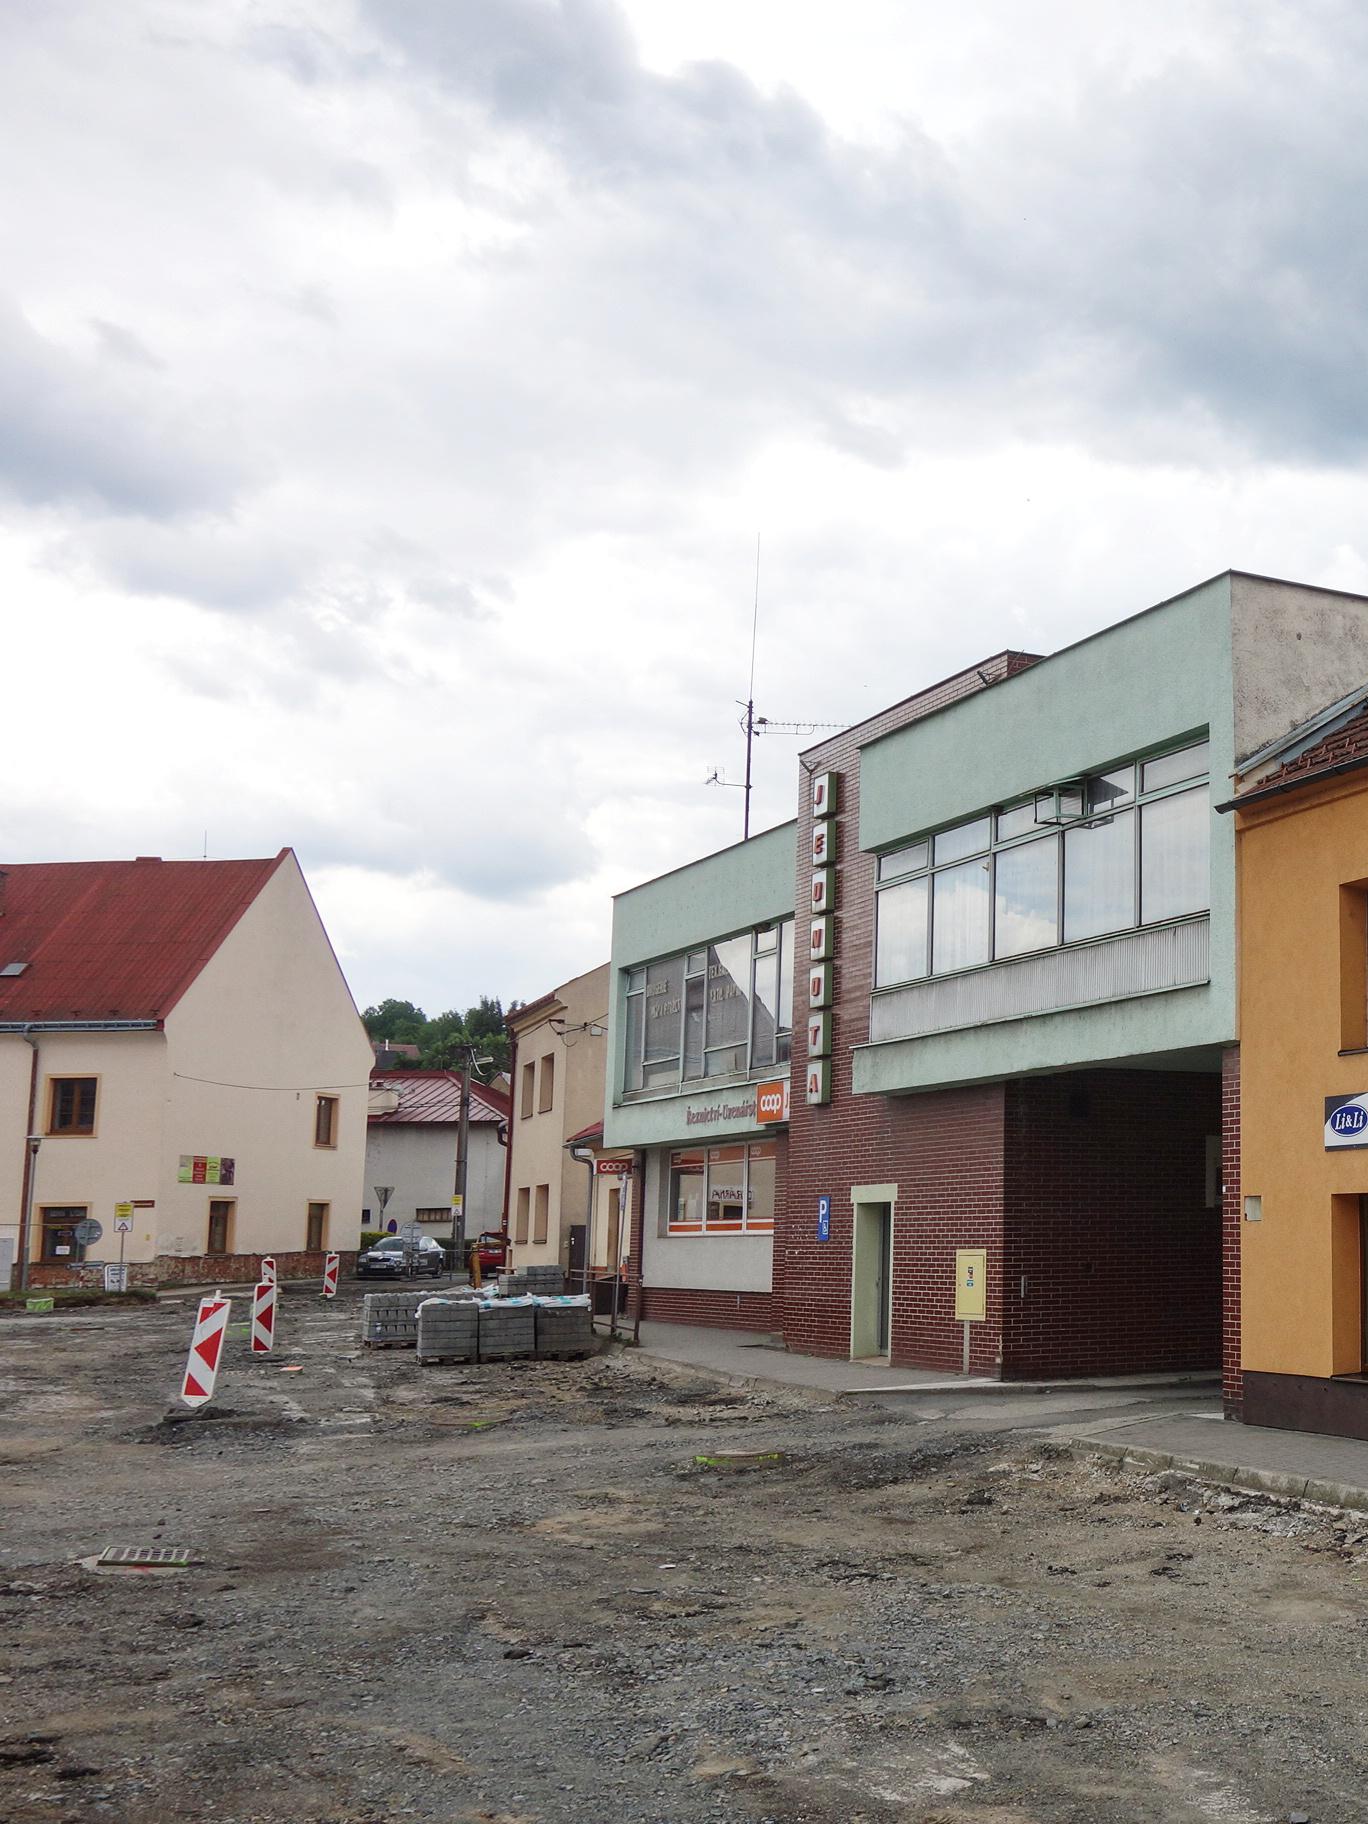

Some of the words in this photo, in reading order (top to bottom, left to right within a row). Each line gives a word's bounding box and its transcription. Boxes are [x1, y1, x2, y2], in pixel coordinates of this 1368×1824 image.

[808, 784, 824, 1094] JEDNOTA
[1334, 1111, 1364, 1130] Li&Li
[819, 1200, 827, 1223] P
